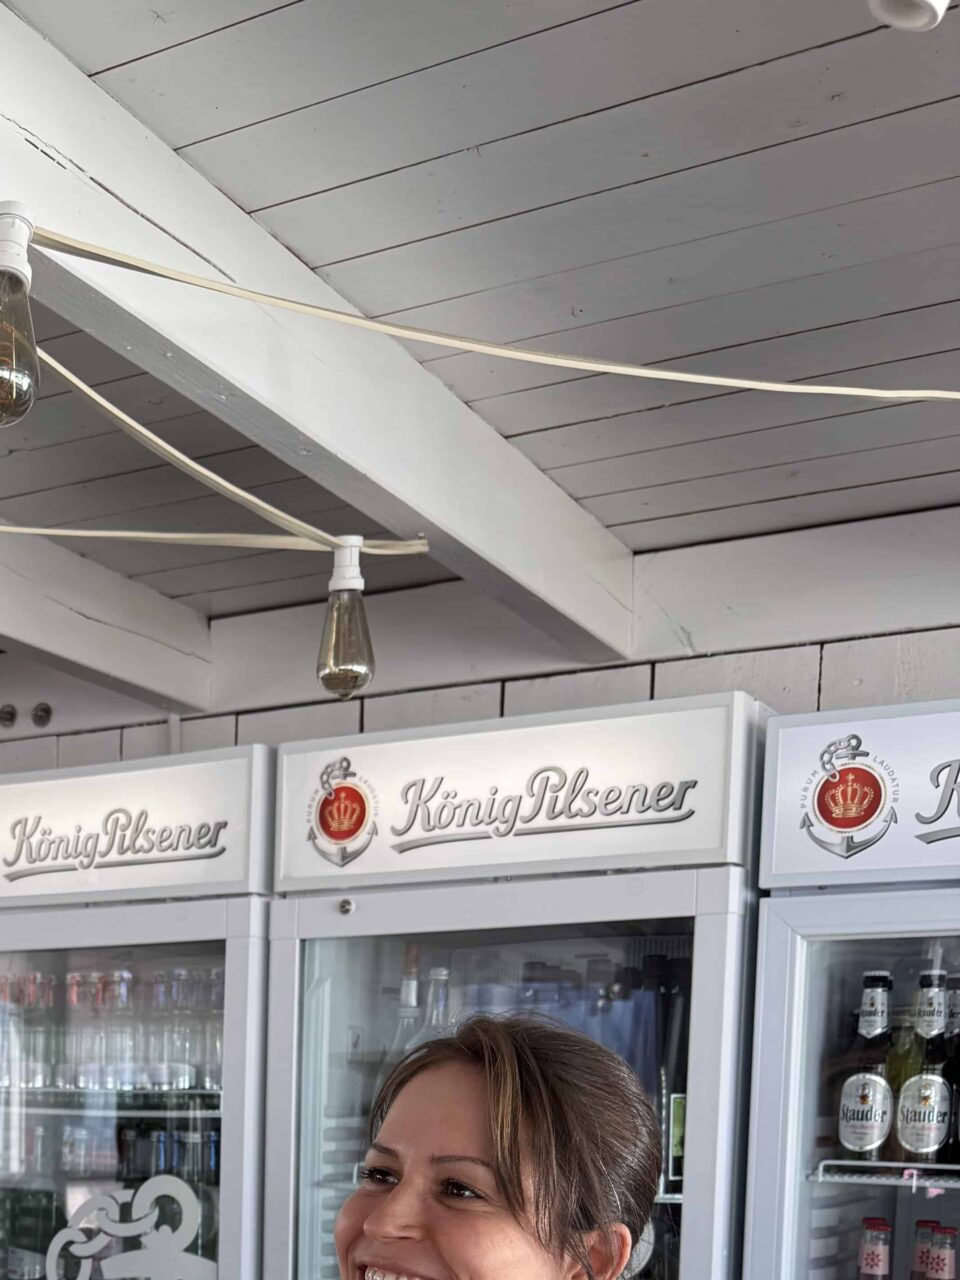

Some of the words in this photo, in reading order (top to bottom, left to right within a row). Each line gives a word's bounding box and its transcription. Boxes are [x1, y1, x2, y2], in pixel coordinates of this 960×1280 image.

[390, 776, 522, 838] König
[519, 765, 698, 824] Pilsener
[800, 769, 819, 809] PURUM
[872, 755, 900, 803] LAUDATUR
[2, 816, 100, 870] König
[98, 808, 228, 858] Pilsener
[841, 1104, 887, 1124] Stauder
[900, 1105, 948, 1125] Stauder
